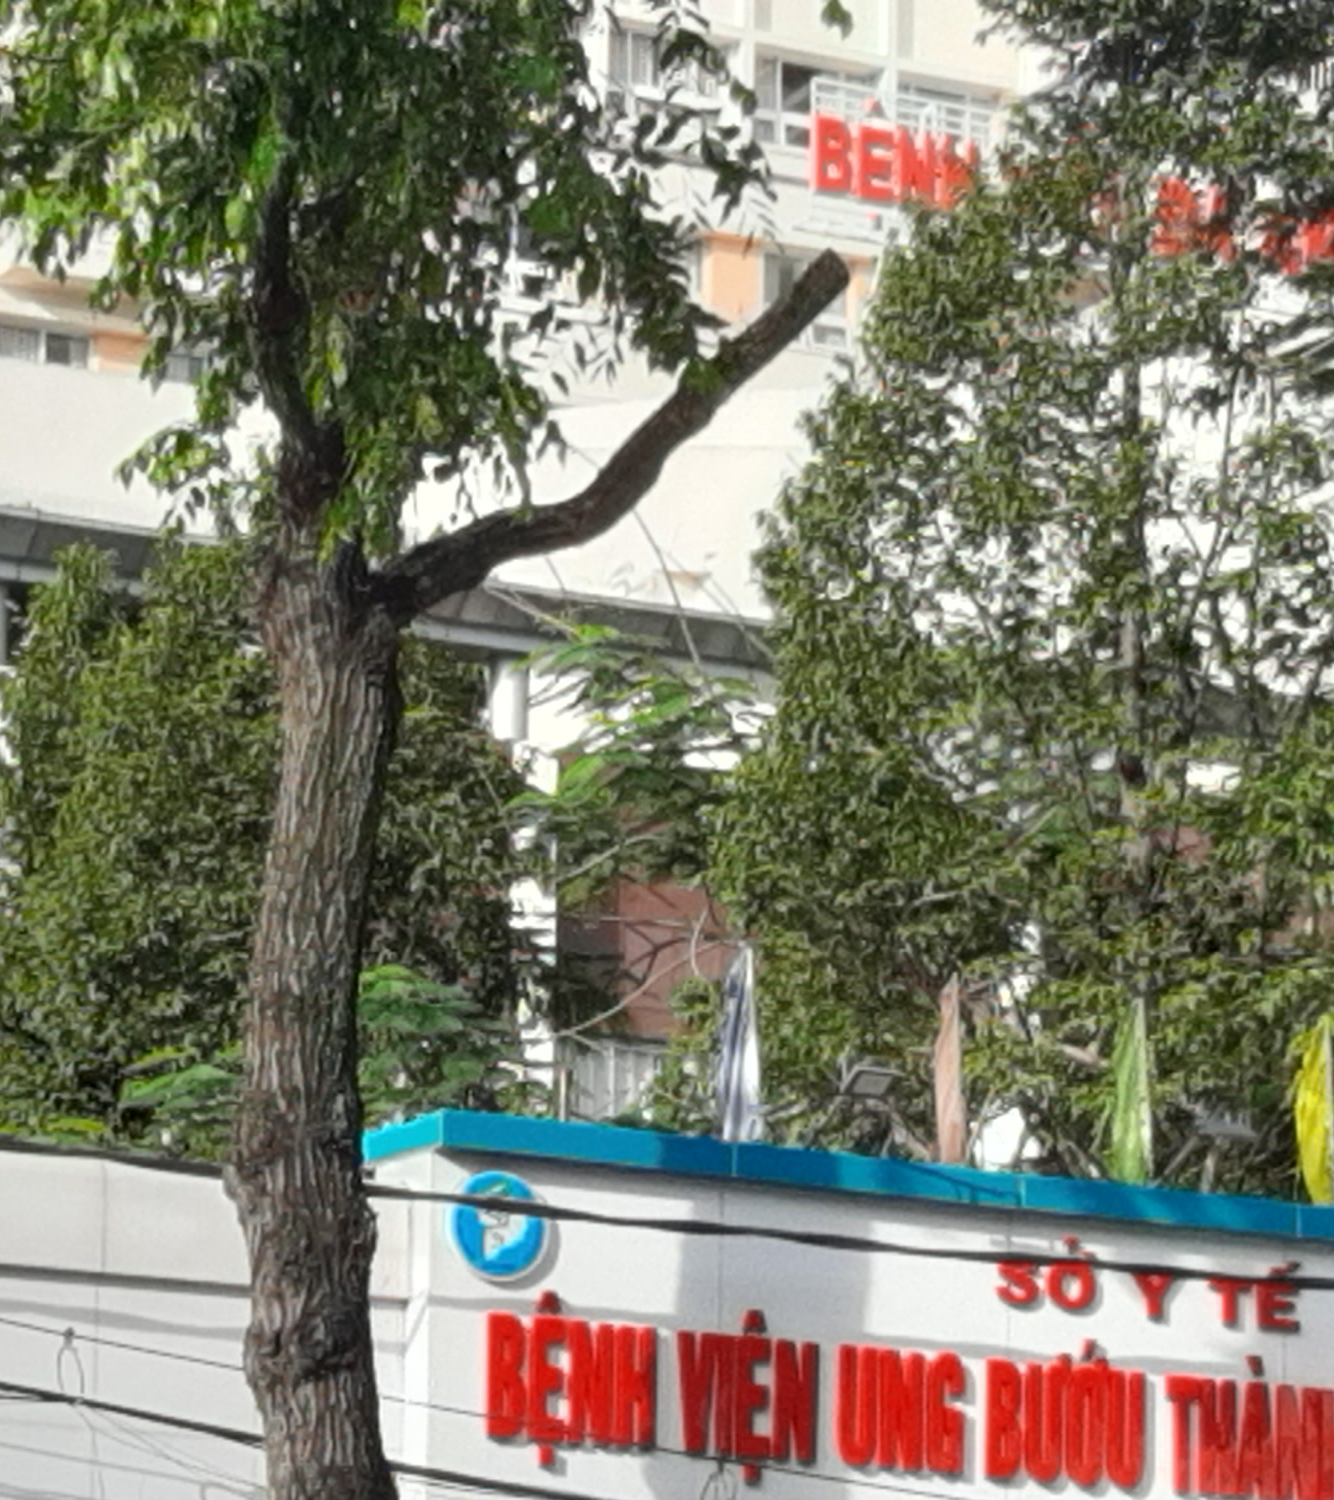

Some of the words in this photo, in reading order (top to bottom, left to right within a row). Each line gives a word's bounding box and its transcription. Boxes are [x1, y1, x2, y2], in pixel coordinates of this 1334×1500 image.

[995, 1236, 1100, 1312] SỞ
[1130, 1262, 1171, 1321] Y
[1209, 1259, 1302, 1332] TẾ
[485, 1289, 657, 1466] BỆNH
[676, 1308, 817, 1482] VIỆN
[984, 1337, 1145, 1488] BƯỚU
